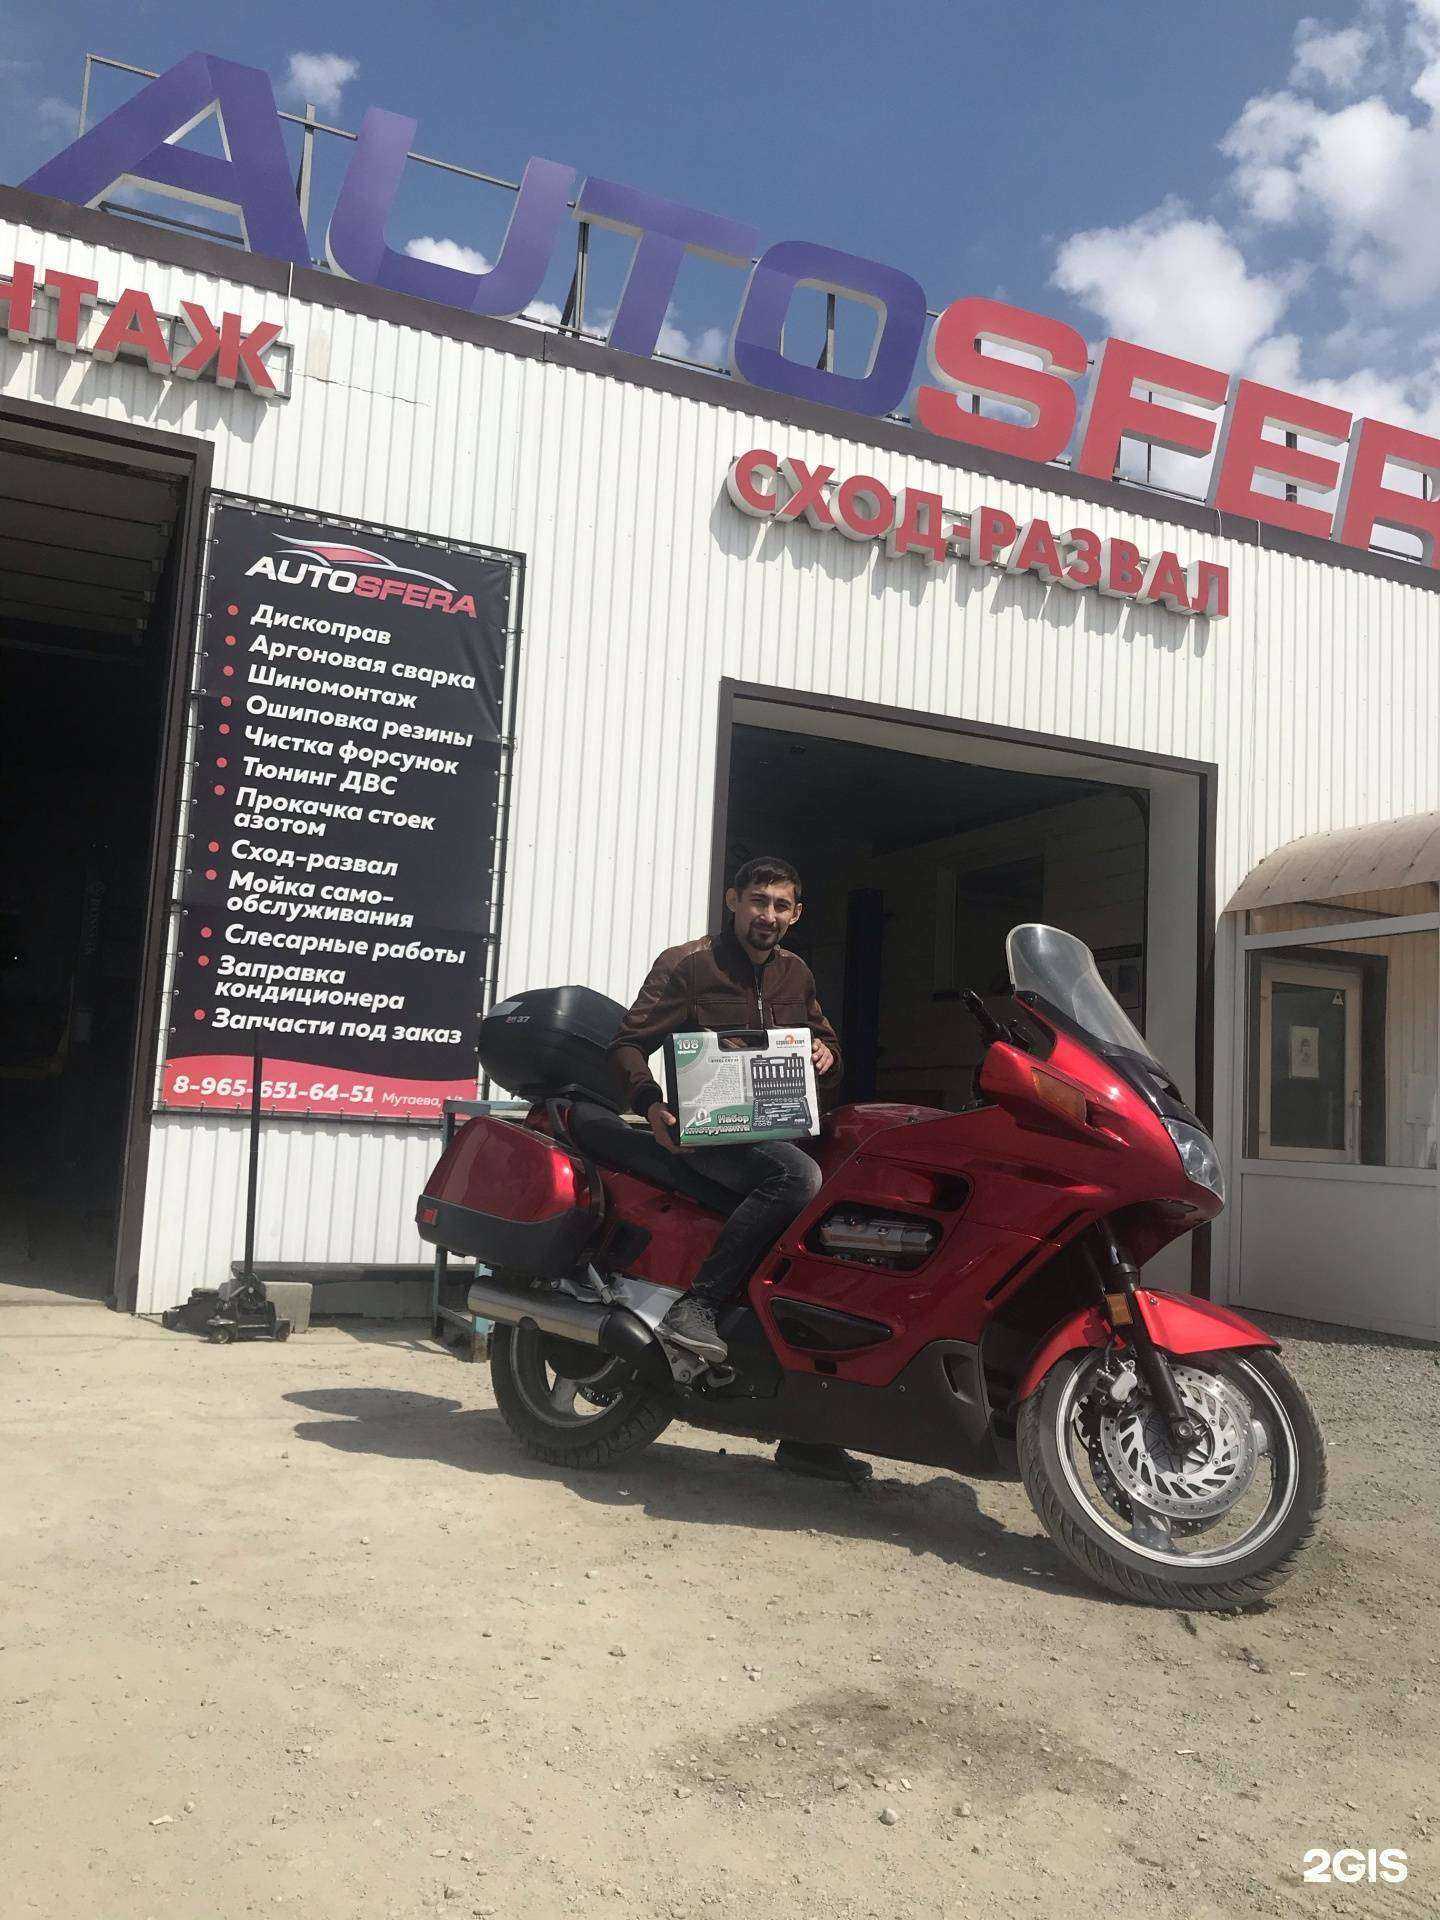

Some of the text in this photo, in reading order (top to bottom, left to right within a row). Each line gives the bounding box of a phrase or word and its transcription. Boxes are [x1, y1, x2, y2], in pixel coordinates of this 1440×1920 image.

[728, 449, 1229, 620] СХОД-РАЗВАЛ
[244, 556, 478, 618] AUTOSFERA
[250, 604, 391, 644] Дископрав
[248, 635, 475, 689] Аргоновая сварка
[248, 664, 417, 708] Шиномонтаж
[247, 695, 473, 747] Ошиповка резины
[245, 725, 459, 774] Чистка форсунок
[244, 756, 397, 795] Тюнинг ДВС
[234, 813, 326, 836] азотом
[235, 786, 436, 830] Прокачка стоек
[232, 839, 398, 876] Сход-развал
[229, 870, 393, 904] Мойка само-
[227, 895, 414, 928] обслуживания
[225, 924, 465, 963] Слесарные работы
[217, 955, 345, 984] Заправка
[215, 982, 404, 1012] кондиционера
[212, 1008, 461, 1043] Запчасти под заказ
[717, 1114, 750, 1124] Набор
